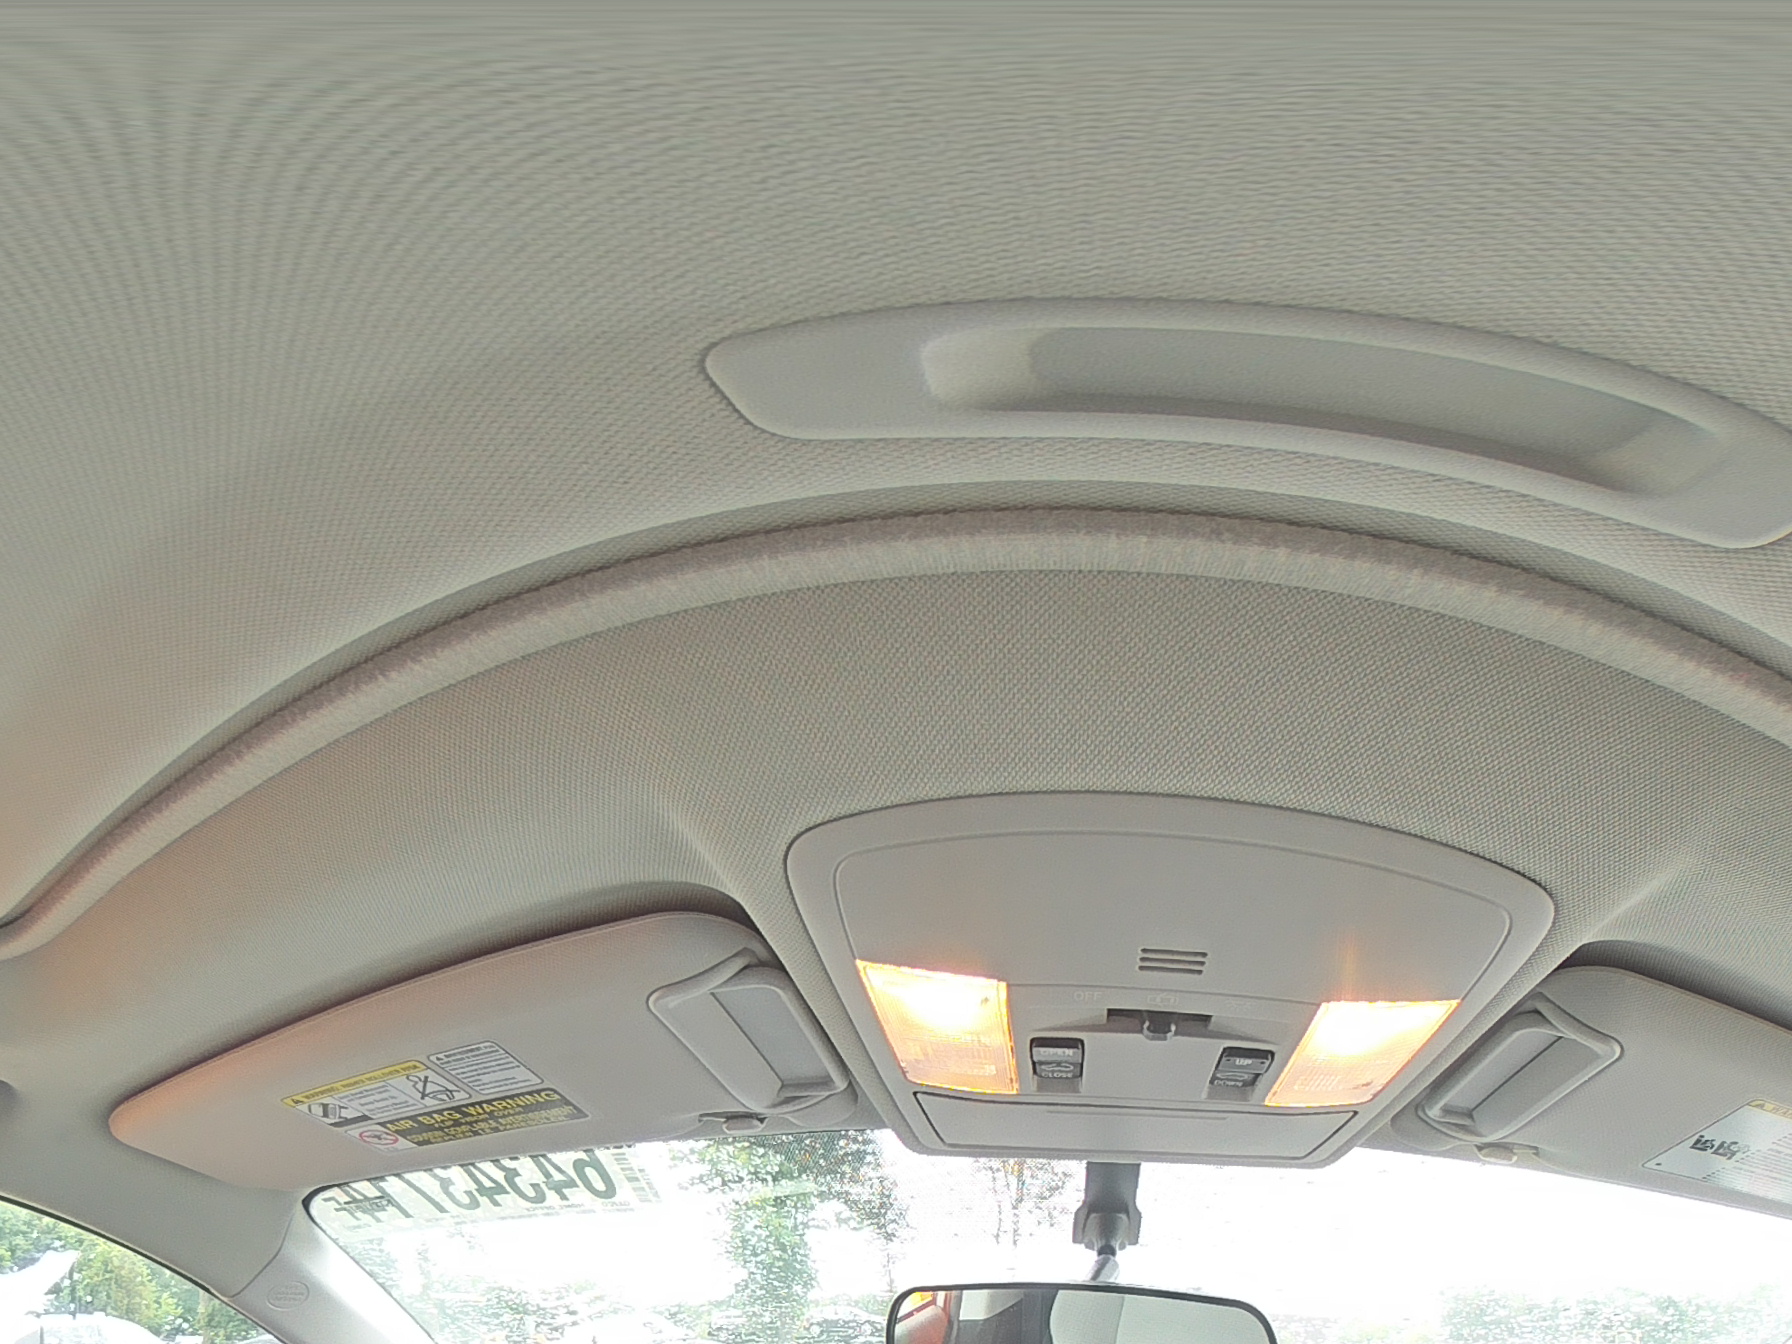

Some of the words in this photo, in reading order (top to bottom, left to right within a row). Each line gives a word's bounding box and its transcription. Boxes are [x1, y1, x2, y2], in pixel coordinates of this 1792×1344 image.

[1073, 990, 1104, 1001] OFF
[1235, 1058, 1253, 1066] UP
[386, 1119, 419, 1132] AIR
[418, 1110, 461, 1125] BAG
[462, 1090, 562, 1118] WARNING
